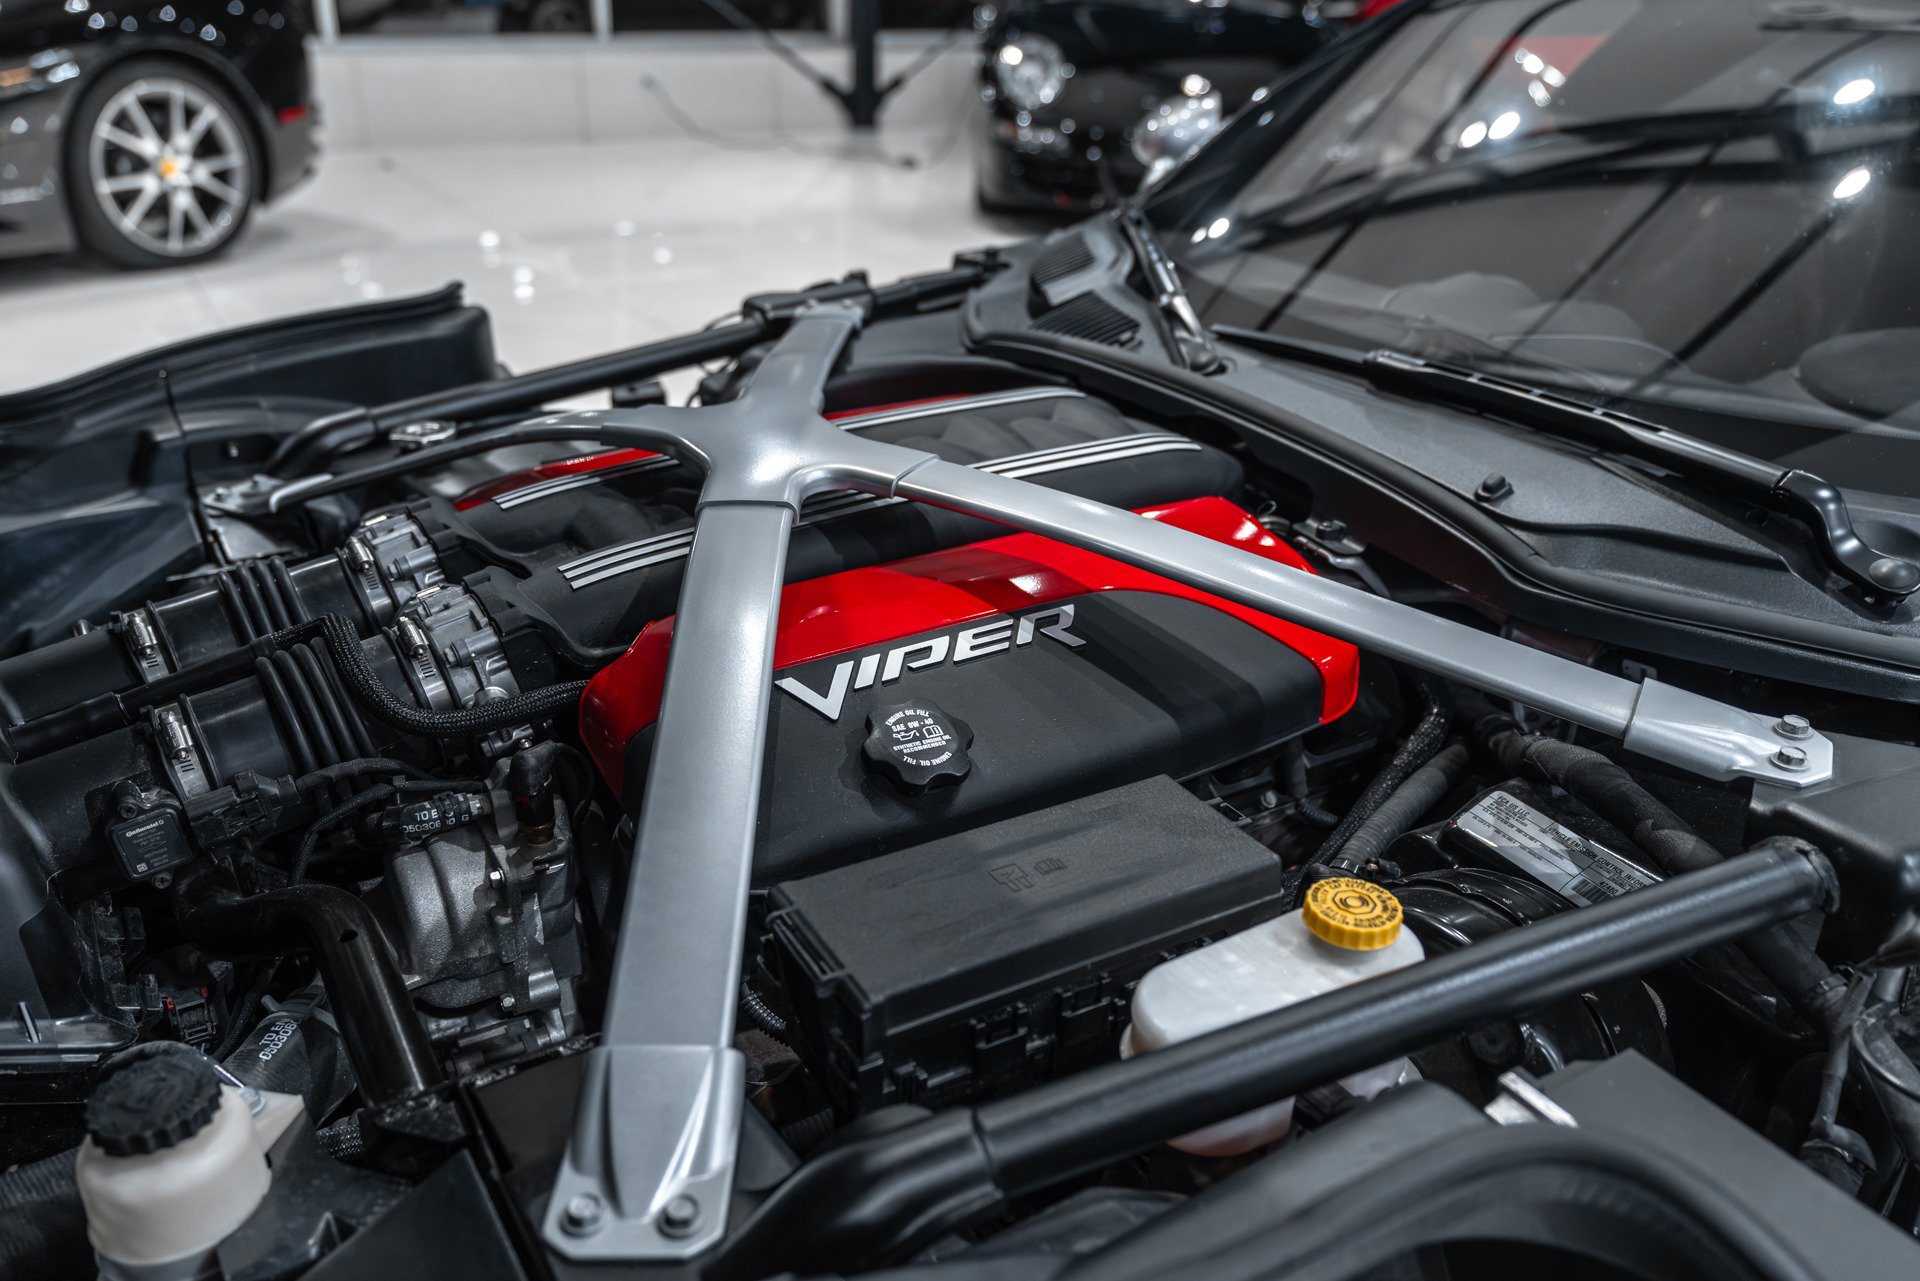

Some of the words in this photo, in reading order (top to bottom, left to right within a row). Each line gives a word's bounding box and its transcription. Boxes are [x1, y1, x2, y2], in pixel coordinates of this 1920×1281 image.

[774, 604, 1087, 722] VIPER
[885, 711, 906, 726] ENGINE
[916, 709, 930, 717] FILL
[891, 723, 906, 732] SAE
[892, 740, 922, 751] SYNTHETIC
[922, 735, 943, 745] ENGINE
[902, 740, 947, 754] RECOMMENDED
[902, 755, 917, 765] FILL
[930, 750, 953, 766] ENGINE
[1497, 795, 1510, 805] FCA
[1509, 803, 1519, 811] US
[1518, 808, 1530, 817] LLC
[1548, 826, 1571, 843] VEHICLE
[1570, 841, 1599, 860] EMISSION
[1597, 857, 1625, 876] CONTROL
